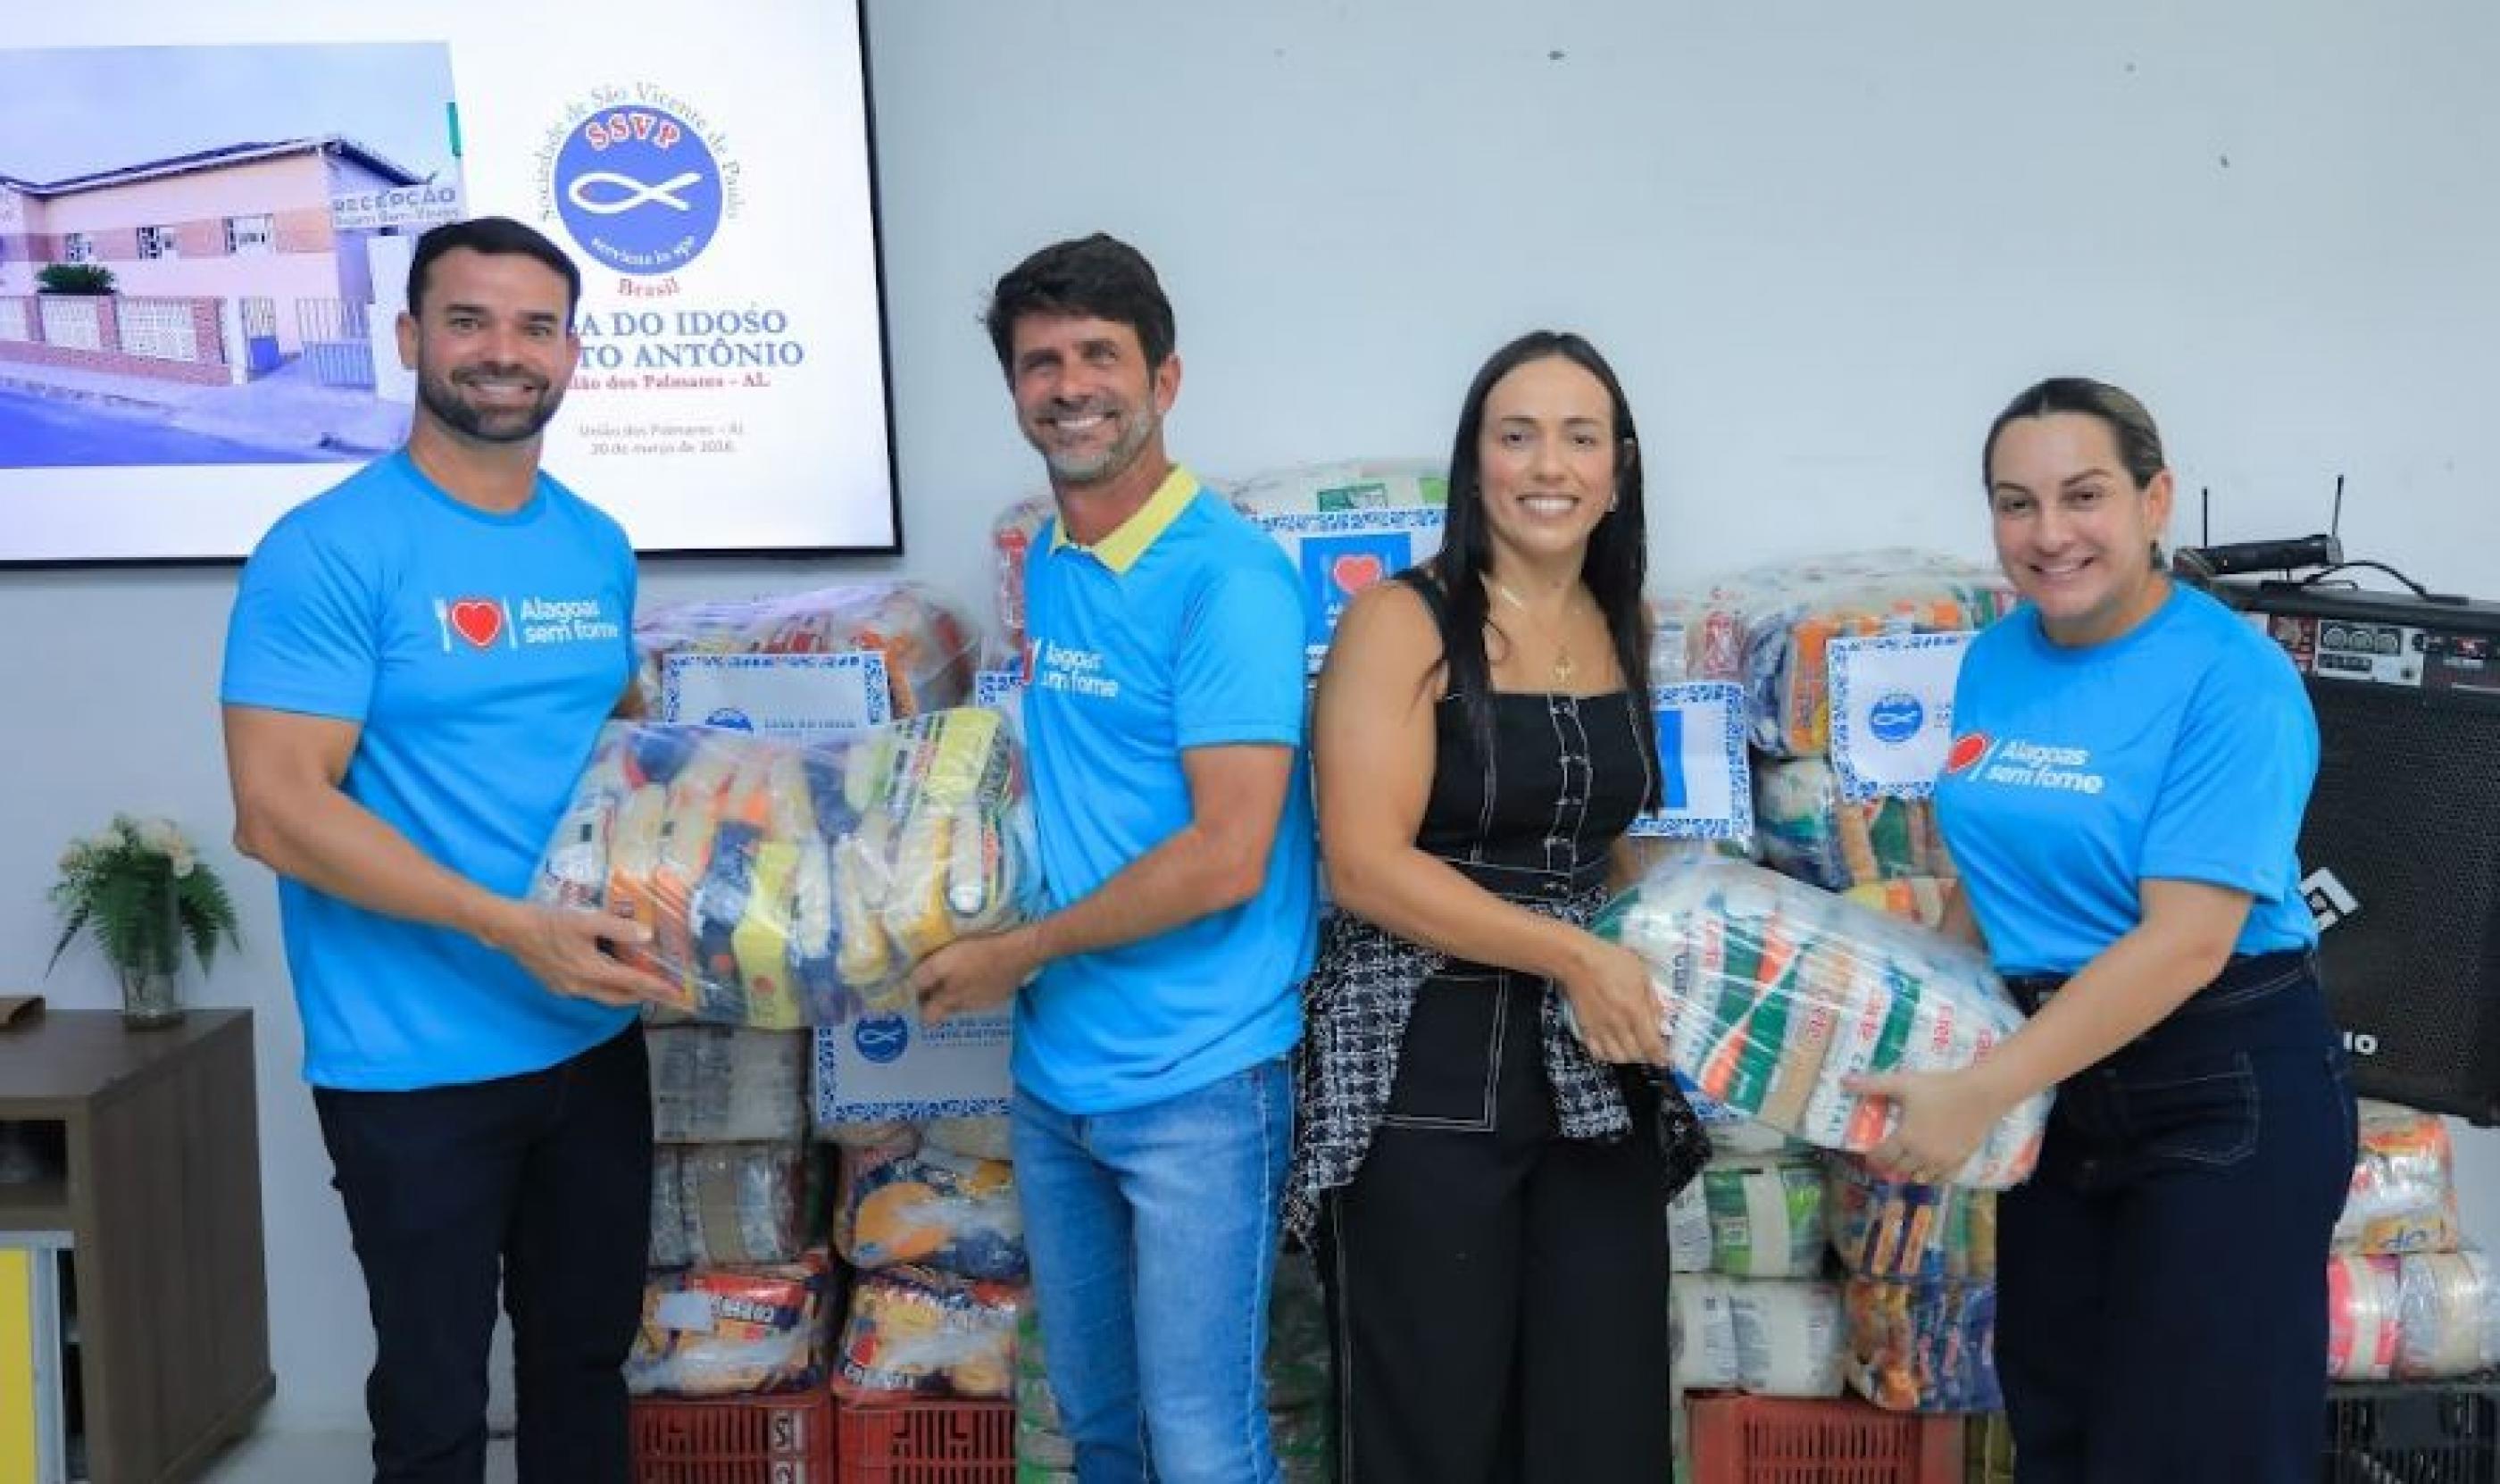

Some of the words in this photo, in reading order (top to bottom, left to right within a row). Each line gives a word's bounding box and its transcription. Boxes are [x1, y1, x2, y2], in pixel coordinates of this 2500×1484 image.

[586, 113, 681, 152] SSVP
[618, 278, 681, 298] Brasil
[612, 310, 665, 337] DO
[634, 338, 805, 368] ANTÔNIO
[605, 374, 638, 390] dos
[643, 373, 723, 389] Palmares
[521, 598, 601, 622] Alagoas
[524, 627, 571, 644] sem
[573, 620, 619, 639] fome
[2000, 740, 2088, 767] Alagoas
[1987, 765, 2038, 786] sem
[2038, 765, 2103, 792] fome
